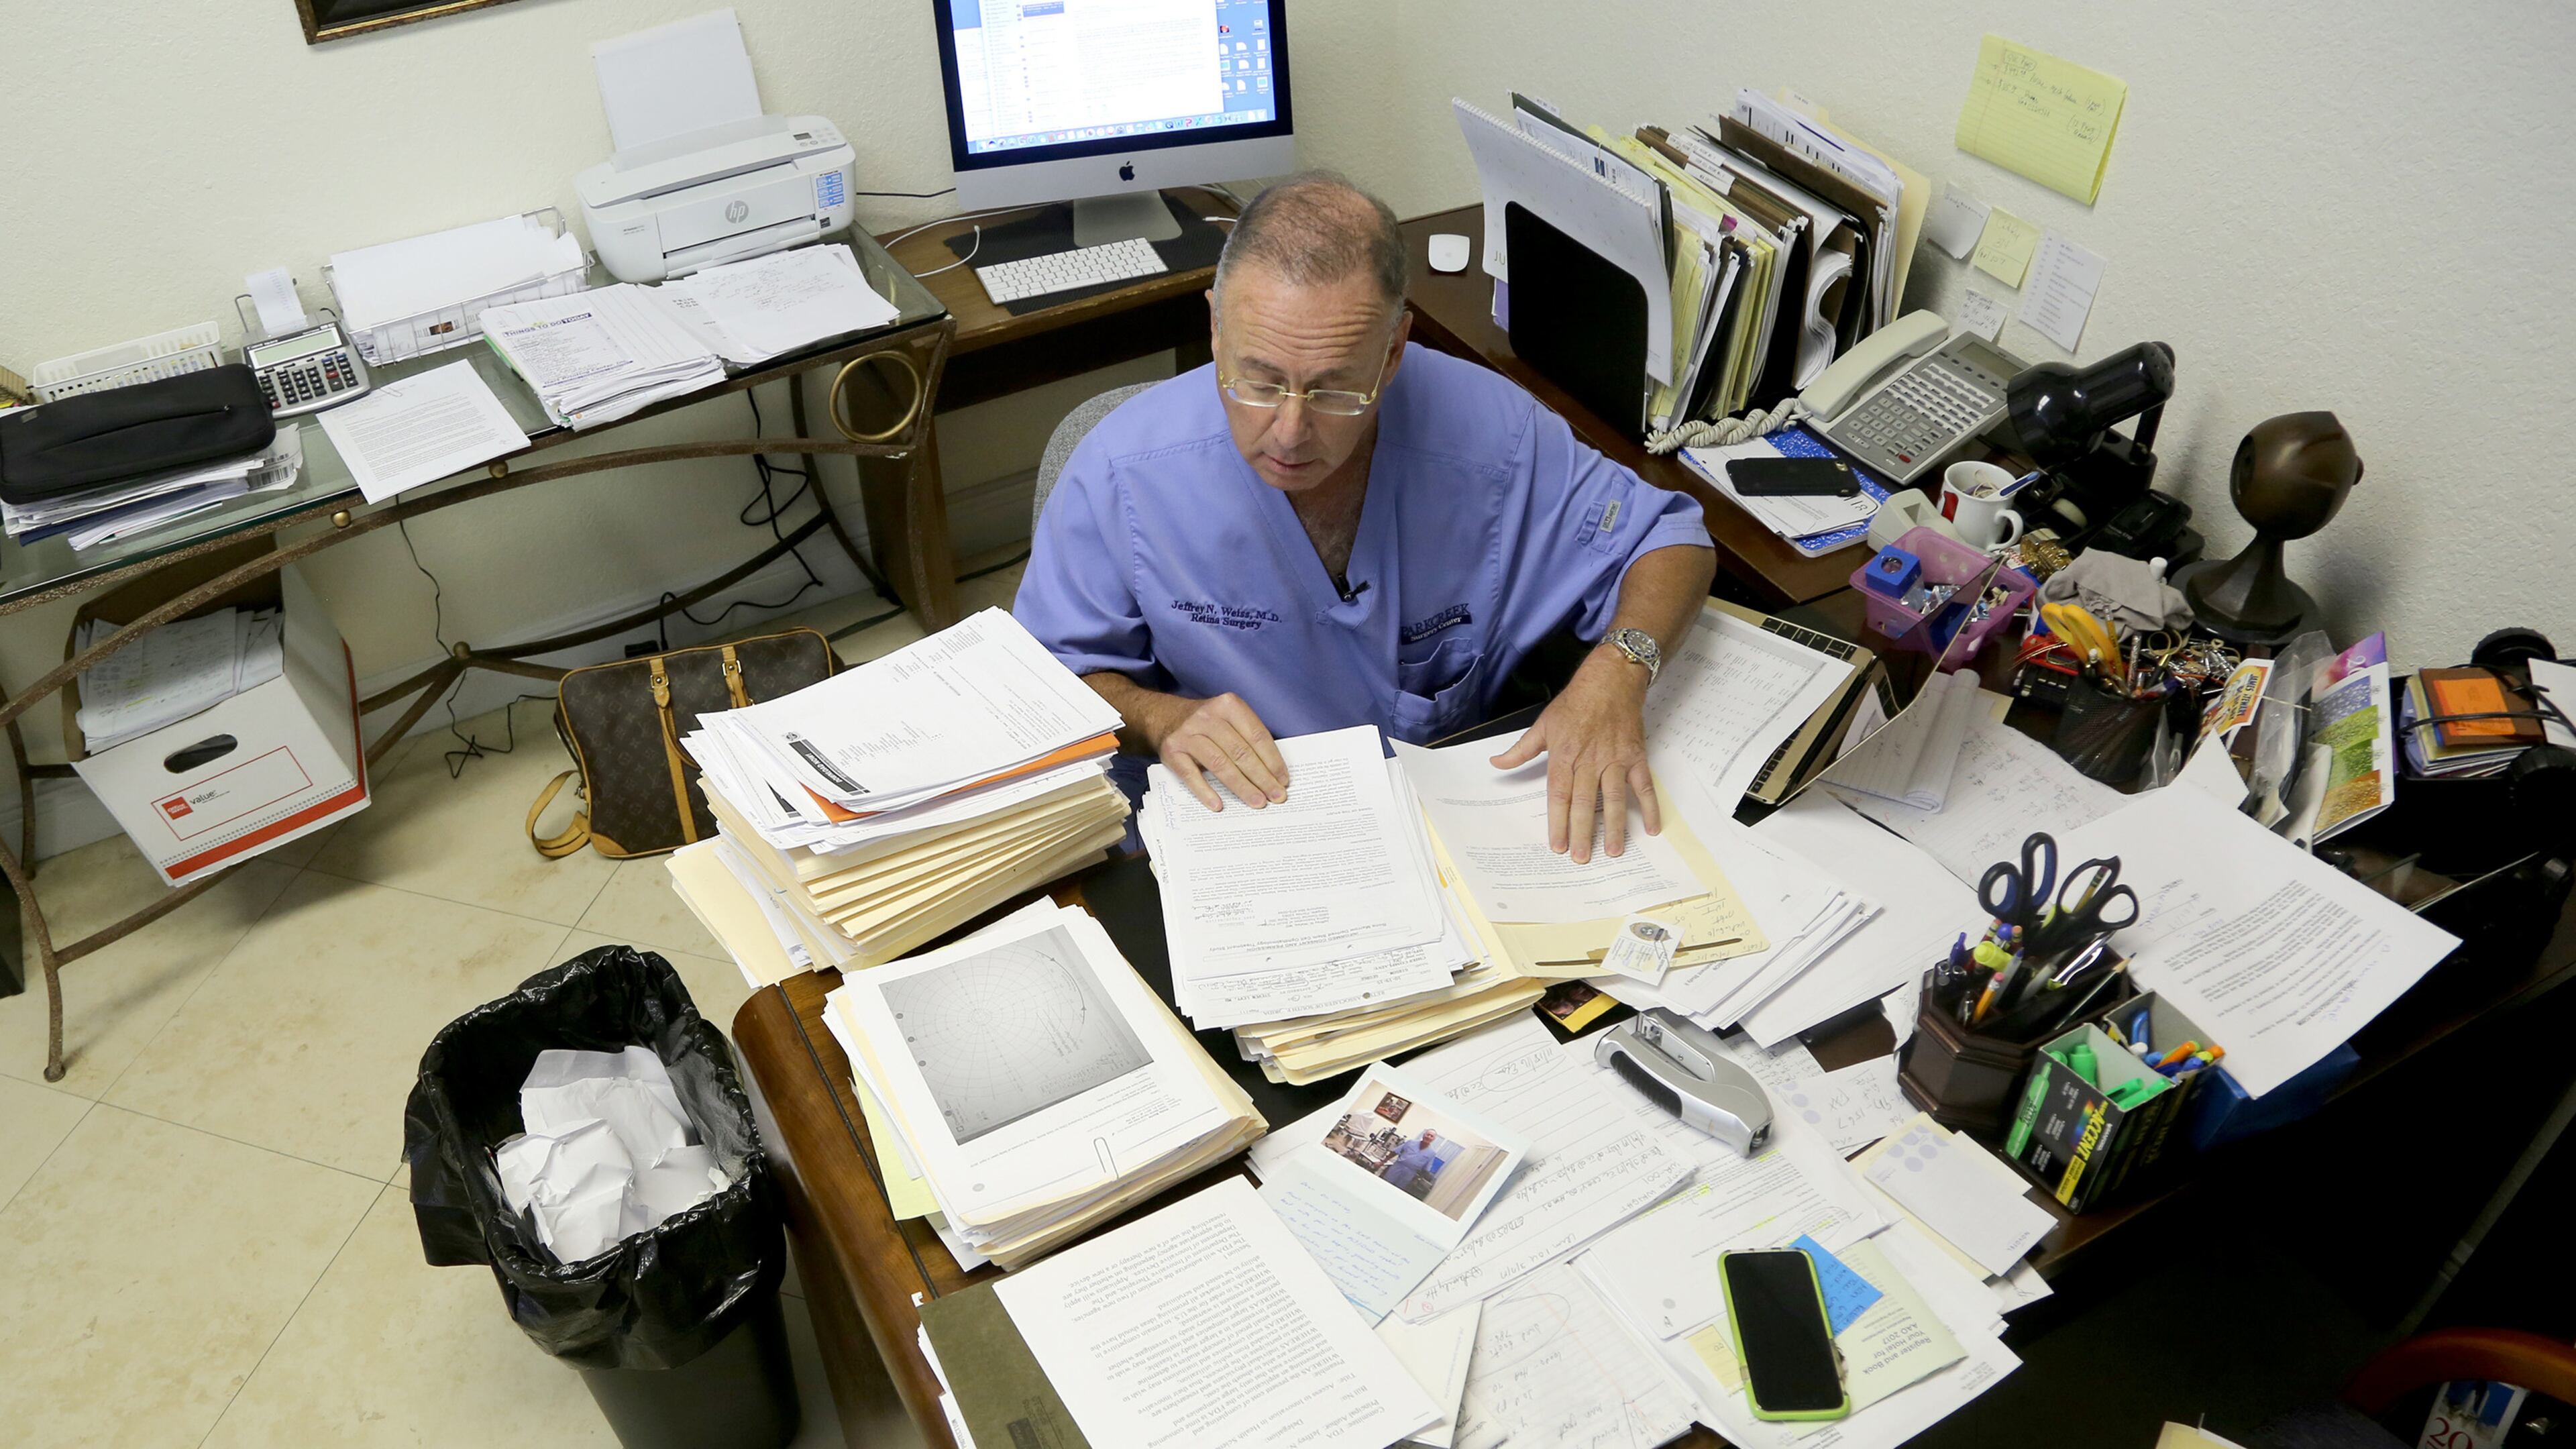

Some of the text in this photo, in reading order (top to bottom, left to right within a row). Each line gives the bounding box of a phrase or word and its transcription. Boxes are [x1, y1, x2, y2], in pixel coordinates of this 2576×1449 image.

[504, 327, 536, 337] THINGS
[564, 313, 590, 323] TODAY
[1171, 600, 1282, 623] Jeffrey N. Weiss, M.D.
[1191, 613, 1262, 630] Retina Surgery
[1411, 616, 1462, 641] Surgery Center
[815, 762, 842, 785] DOWNLOAD
[189, 790, 216, 804] value
[2074, 1114, 2106, 1161] ACCENT
[1189, 1210, 1227, 1232] researching
[1177, 1225, 1214, 1246] appropriate
[1198, 1222, 1236, 1244] Department
[1155, 1241, 1178, 1256] agency
[1158, 1244, 1193, 1265] Innovative
[1189, 1234, 1228, 1258] Department
[1202, 1250, 1217, 1260] will
[1226, 1242, 1252, 1258] Section
[1116, 1250, 1143, 1267] therapy
[1121, 1252, 1157, 1273] depending
[1149, 1257, 1185, 1278] Innovative
[1173, 1256, 1204, 1275] authorize
[1072, 1283, 1089, 1295] they
[1087, 1273, 1114, 1289] whether
[1093, 1273, 1130, 1295] Applicants
[1136, 1276, 1164, 1293] creation
[1062, 1295, 1083, 1309] apply
[1081, 1290, 1096, 1301] will
[1872, 1328, 1925, 1359] Your Hotel for
[1882, 1322, 1918, 1345] AAO 2017
[1281, 1343, 1316, 1366] expensive
[1299, 1350, 1340, 1375] WHEREAS
[1862, 1336, 1931, 1377] Register and Book
[1252, 1369, 1269, 1381] that
[1266, 1361, 1284, 1375] such
[1218, 1384, 1240, 1400] large
[1236, 1375, 1255, 1390] only
[1263, 1375, 1290, 1394] present
[1310, 1381, 1336, 1398] Access
[1352, 1383, 1368, 1395] Bill
[1249, 1389, 1267, 1402] cost
[1183, 1393, 1222, 1420] companies
[1203, 1401, 1243, 1428] completing
[1267, 1397, 1305, 1422] Innovation
[1345, 1395, 1379, 1418] Principal
[1236, 1421, 1261, 1440] Health
[1295, 1426, 1322, 1446] Jeffrey
